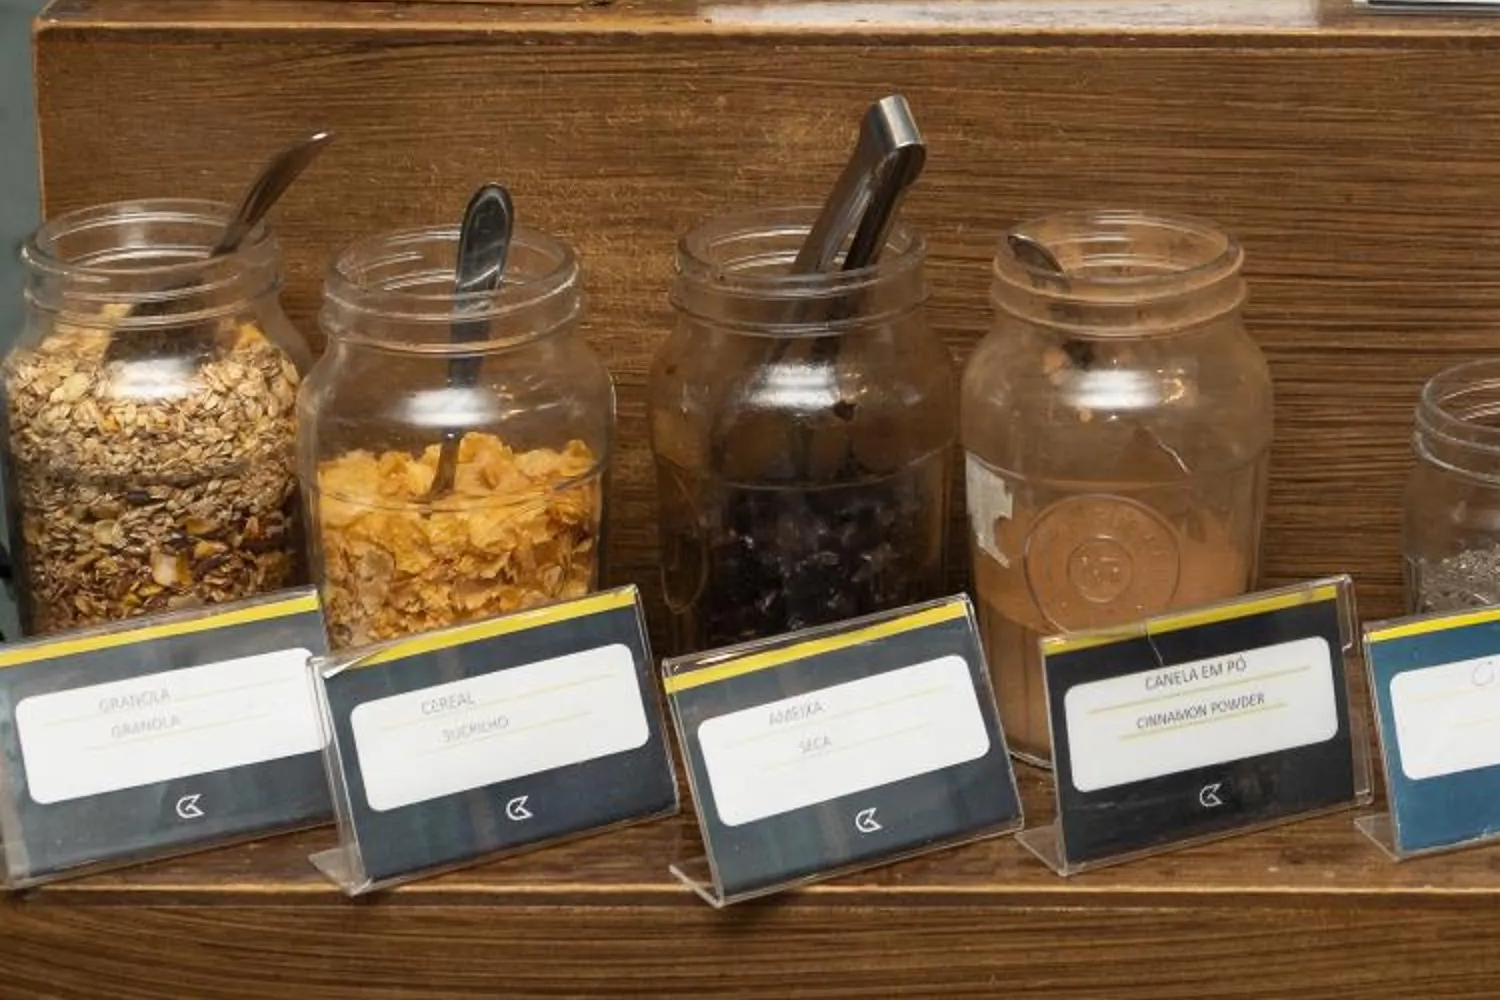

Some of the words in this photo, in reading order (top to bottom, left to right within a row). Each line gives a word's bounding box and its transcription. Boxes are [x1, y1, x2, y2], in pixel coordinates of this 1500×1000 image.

[1145, 666, 1198, 690] CANELA
[1201, 662, 1223, 679] EM
[1226, 655, 1247, 675] PÓ
[421, 692, 475, 714] CEREAL
[1136, 704, 1208, 729] CINNAMON
[1211, 692, 1265, 715] POWDER
[111, 713, 180, 739] GRANOLA
